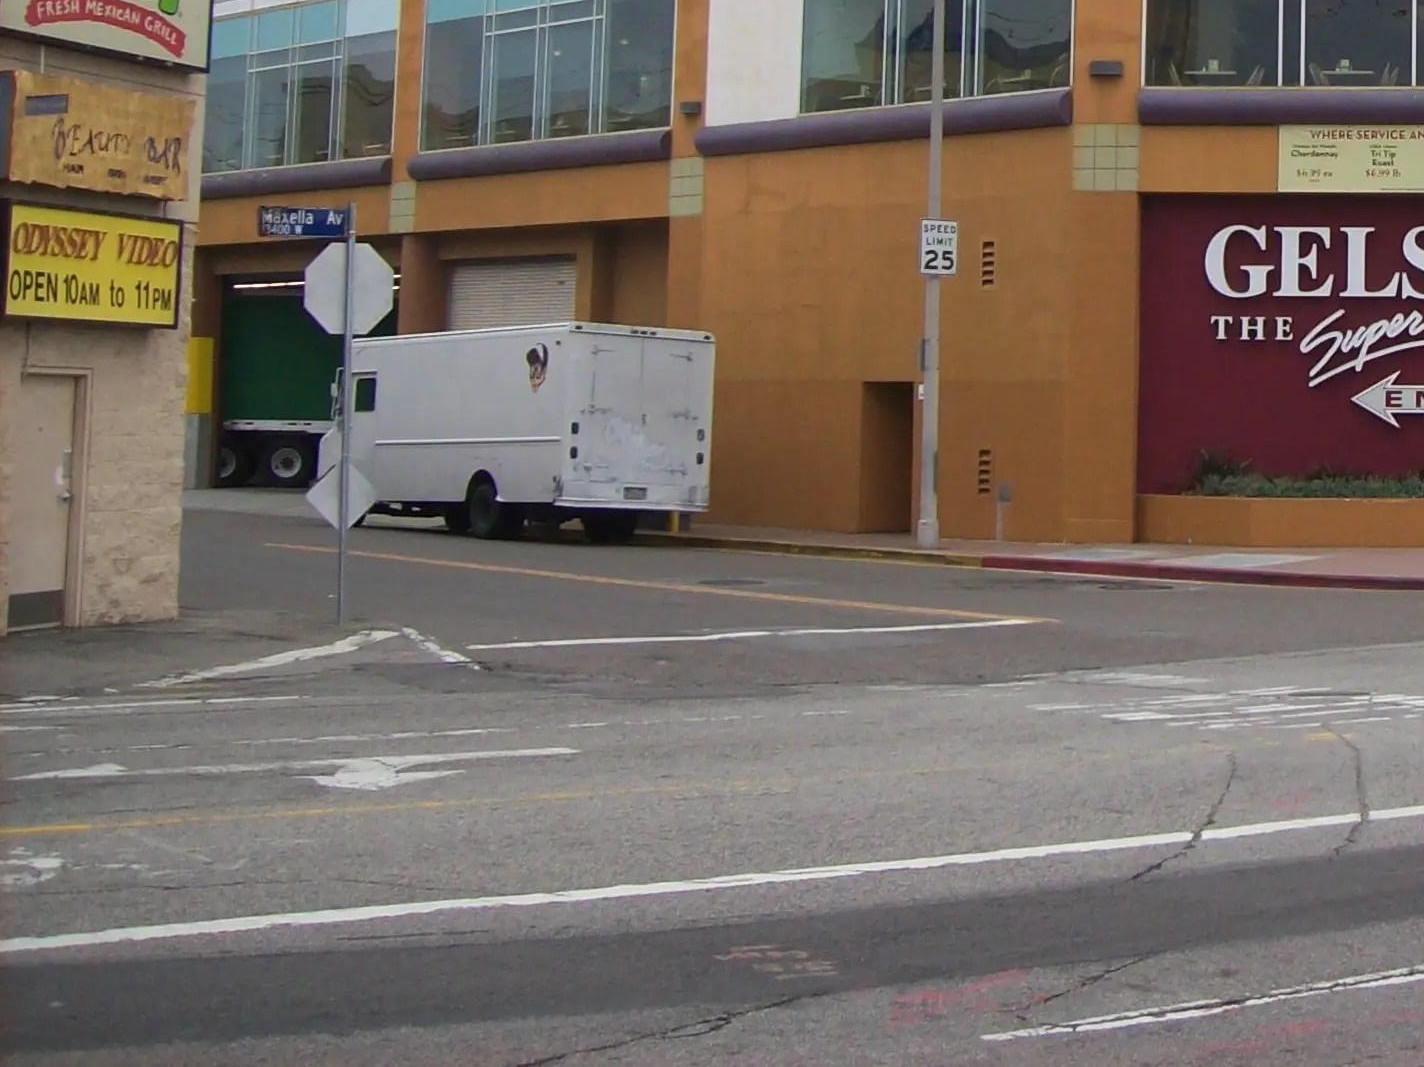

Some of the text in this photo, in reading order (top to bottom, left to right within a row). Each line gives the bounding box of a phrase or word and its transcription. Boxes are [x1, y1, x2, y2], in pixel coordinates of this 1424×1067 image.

[36, 0, 178, 45] FRESH MEXICAN GRILL
[1310, 129, 1353, 141] WHERE
[1356, 129, 1406, 141] SERVICE
[144, 136, 183, 177] BAR
[262, 210, 344, 225] Maxella Av
[294, 224, 304, 234] W
[923, 224, 957, 234] SPEED
[12, 221, 178, 268] ODYSSEY VIDEO
[926, 237, 953, 246] LIMIT
[923, 249, 955, 271] 25
[9, 269, 59, 303] OPEN
[109, 279, 125, 307] to
[1210, 315, 1294, 341] THE
